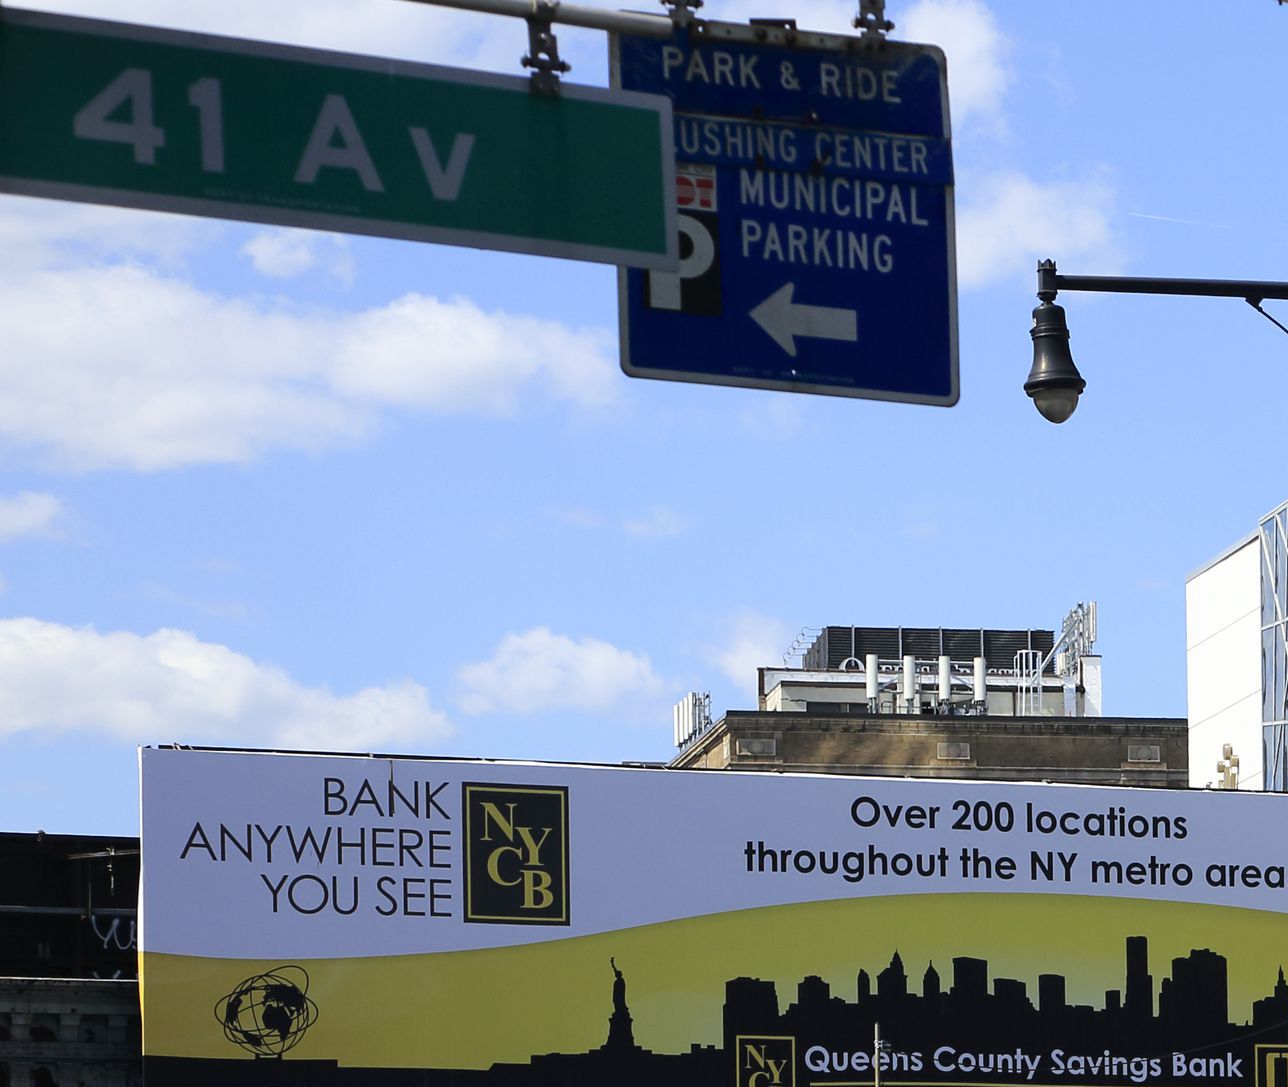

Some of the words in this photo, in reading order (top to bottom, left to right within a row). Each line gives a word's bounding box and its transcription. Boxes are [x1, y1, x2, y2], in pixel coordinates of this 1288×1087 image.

[661, 46, 760, 89] PARK
[780, 61, 800, 90] &
[820, 63, 901, 103] RIDE
[73, 68, 225, 173] 41
[294, 95, 475, 201] Av
[815, 133, 929, 175] CENTER
[740, 169, 929, 226] MUNICIPAL
[740, 219, 893, 273] PARKING
[323, 777, 451, 821] BANK
[850, 795, 940, 831] Over
[951, 801, 1015, 833] 200
[1025, 802, 1189, 840] locations
[180, 821, 452, 869] ANYWHERE
[743, 841, 949, 883] throughout
[959, 847, 1017, 881] the
[1029, 852, 1078, 884] NY
[1089, 856, 1194, 887] metro
[260, 874, 360, 915] YOU
[375, 876, 453, 918] SEE
[804, 1046, 924, 1076] Queens
[933, 1047, 1039, 1081] County
[1050, 1049, 1162, 1083] Savings
[1172, 1051, 1244, 1079] Bank
